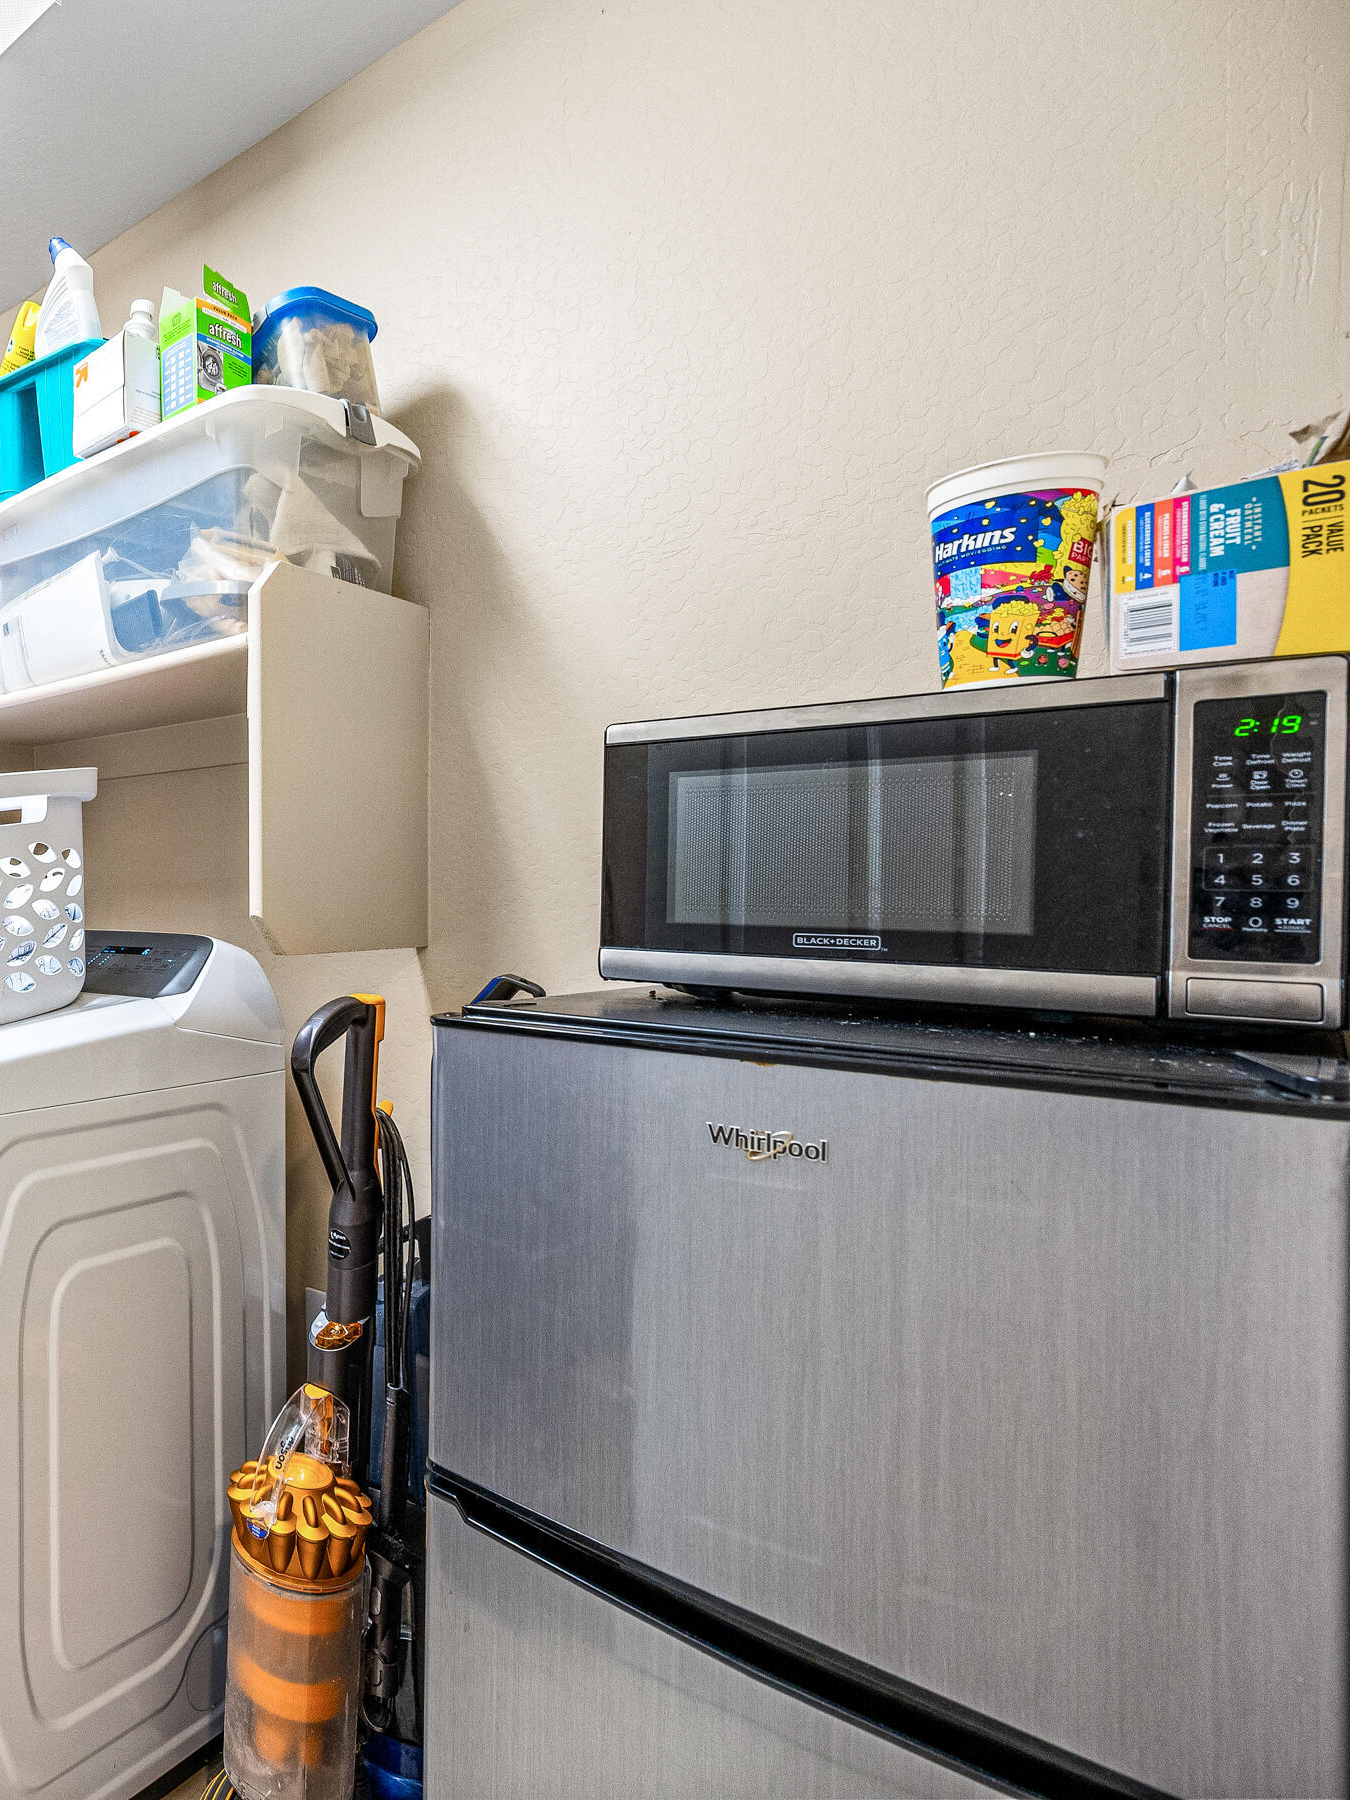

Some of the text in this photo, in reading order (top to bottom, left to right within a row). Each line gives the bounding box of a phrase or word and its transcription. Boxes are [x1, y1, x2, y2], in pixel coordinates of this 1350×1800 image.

[212, 281, 238, 304] affresh
[213, 306, 227, 316] VALUE
[208, 323, 242, 350] affresh
[1302, 475, 1346, 506] 20
[1210, 503, 1225, 512] &
[1301, 504, 1344, 517] PACKETS
[1226, 508, 1241, 544] FRUIT
[1244, 503, 1253, 545] OATMEAL
[1253, 503, 1262, 542] INSTANT
[1209, 514, 1225, 557] CREAM
[1302, 525, 1323, 558] PACK
[1327, 520, 1344, 554] VALUE
[935, 527, 1017, 564] Harkins
[960, 545, 1007, 559] MOVIEGOING
[1234, 715, 1302, 737] 2:19
[1217, 853, 1224, 864] 1
[1251, 852, 1264, 864] 2
[1289, 852, 1301, 864] 3
[1214, 874, 1226, 885] 4
[1251, 874, 1264, 886] 5
[1287, 874, 1300, 886] 6
[1214, 896, 1226, 907] 7
[1250, 897, 1263, 908] 8
[1286, 897, 1300, 909] 9
[1274, 918, 1312, 926] START
[796, 937, 877, 947] BLACK+DECKER
[706, 1121, 828, 1163] Whirlpool
